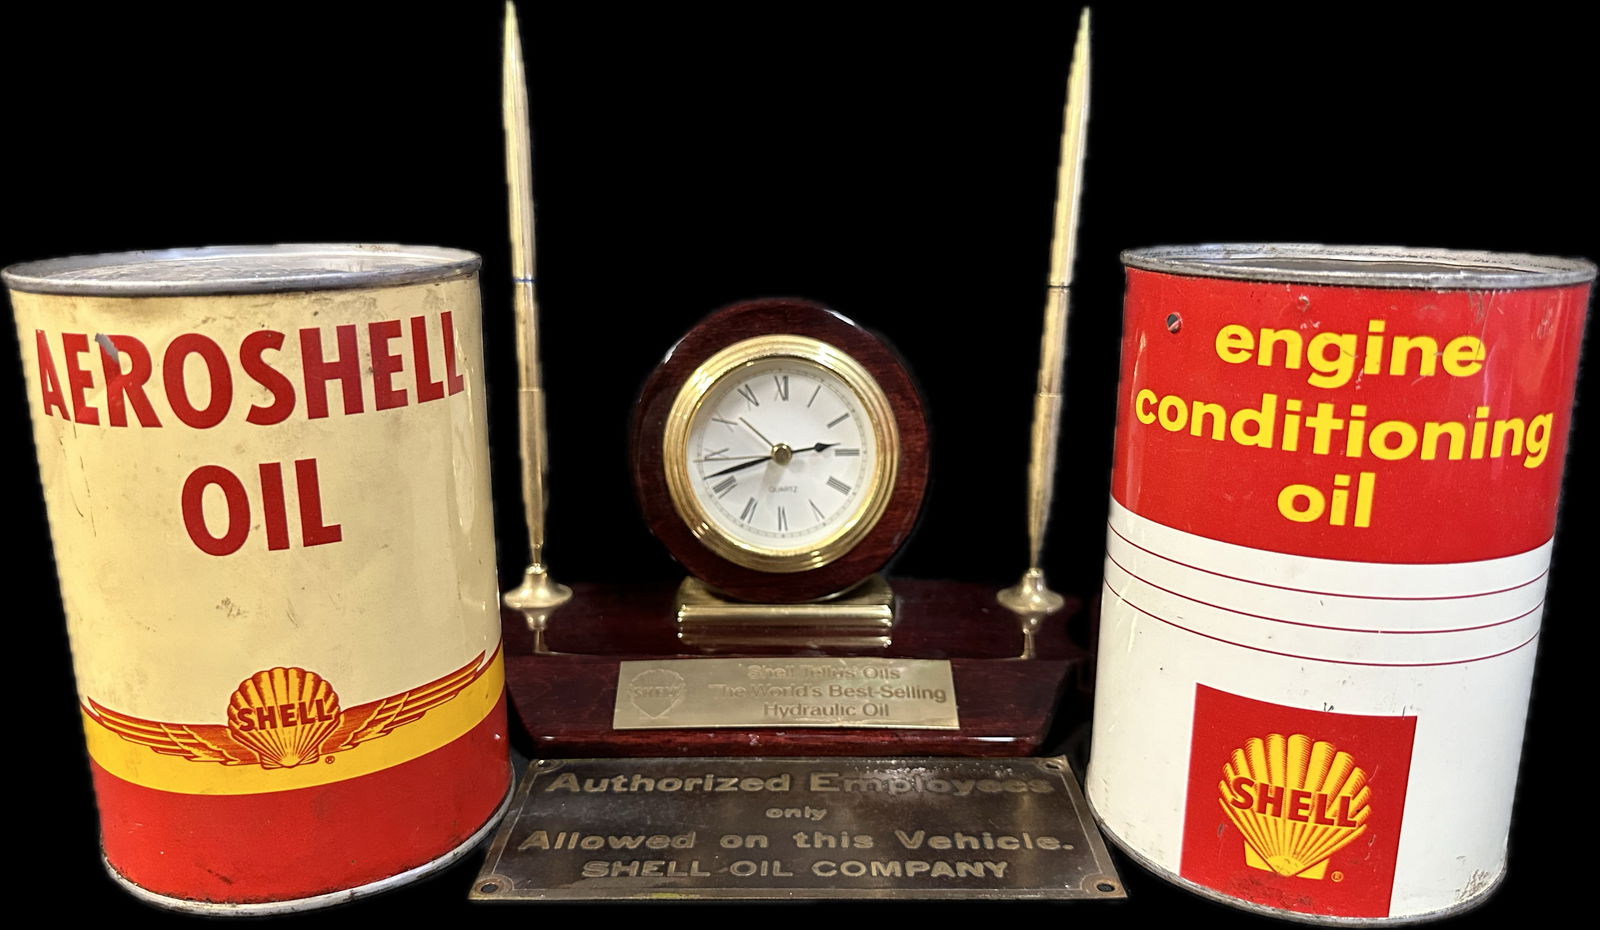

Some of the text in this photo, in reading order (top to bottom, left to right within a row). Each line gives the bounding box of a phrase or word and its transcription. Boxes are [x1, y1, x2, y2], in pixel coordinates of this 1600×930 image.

[1215, 319, 1486, 389] engine
[35, 311, 464, 429] AEROSHELL
[1135, 388, 1554, 468] conditioning
[181, 457, 342, 557] OIL
[1277, 471, 1375, 528] oil
[747, 665, 901, 680] Shell Tellus Oils
[708, 683, 947, 703] The World's Best-Selling
[237, 698, 333, 732] SHELL
[764, 701, 889, 719] Hydraulic Oil
[545, 772, 1054, 796] Authorized Employees
[765, 805, 827, 821] only
[1230, 776, 1357, 828] SHELL
[517, 830, 1074, 850] Allowed on this Vehicle.
[582, 860, 1008, 878] SHELL OIL COMPANY
